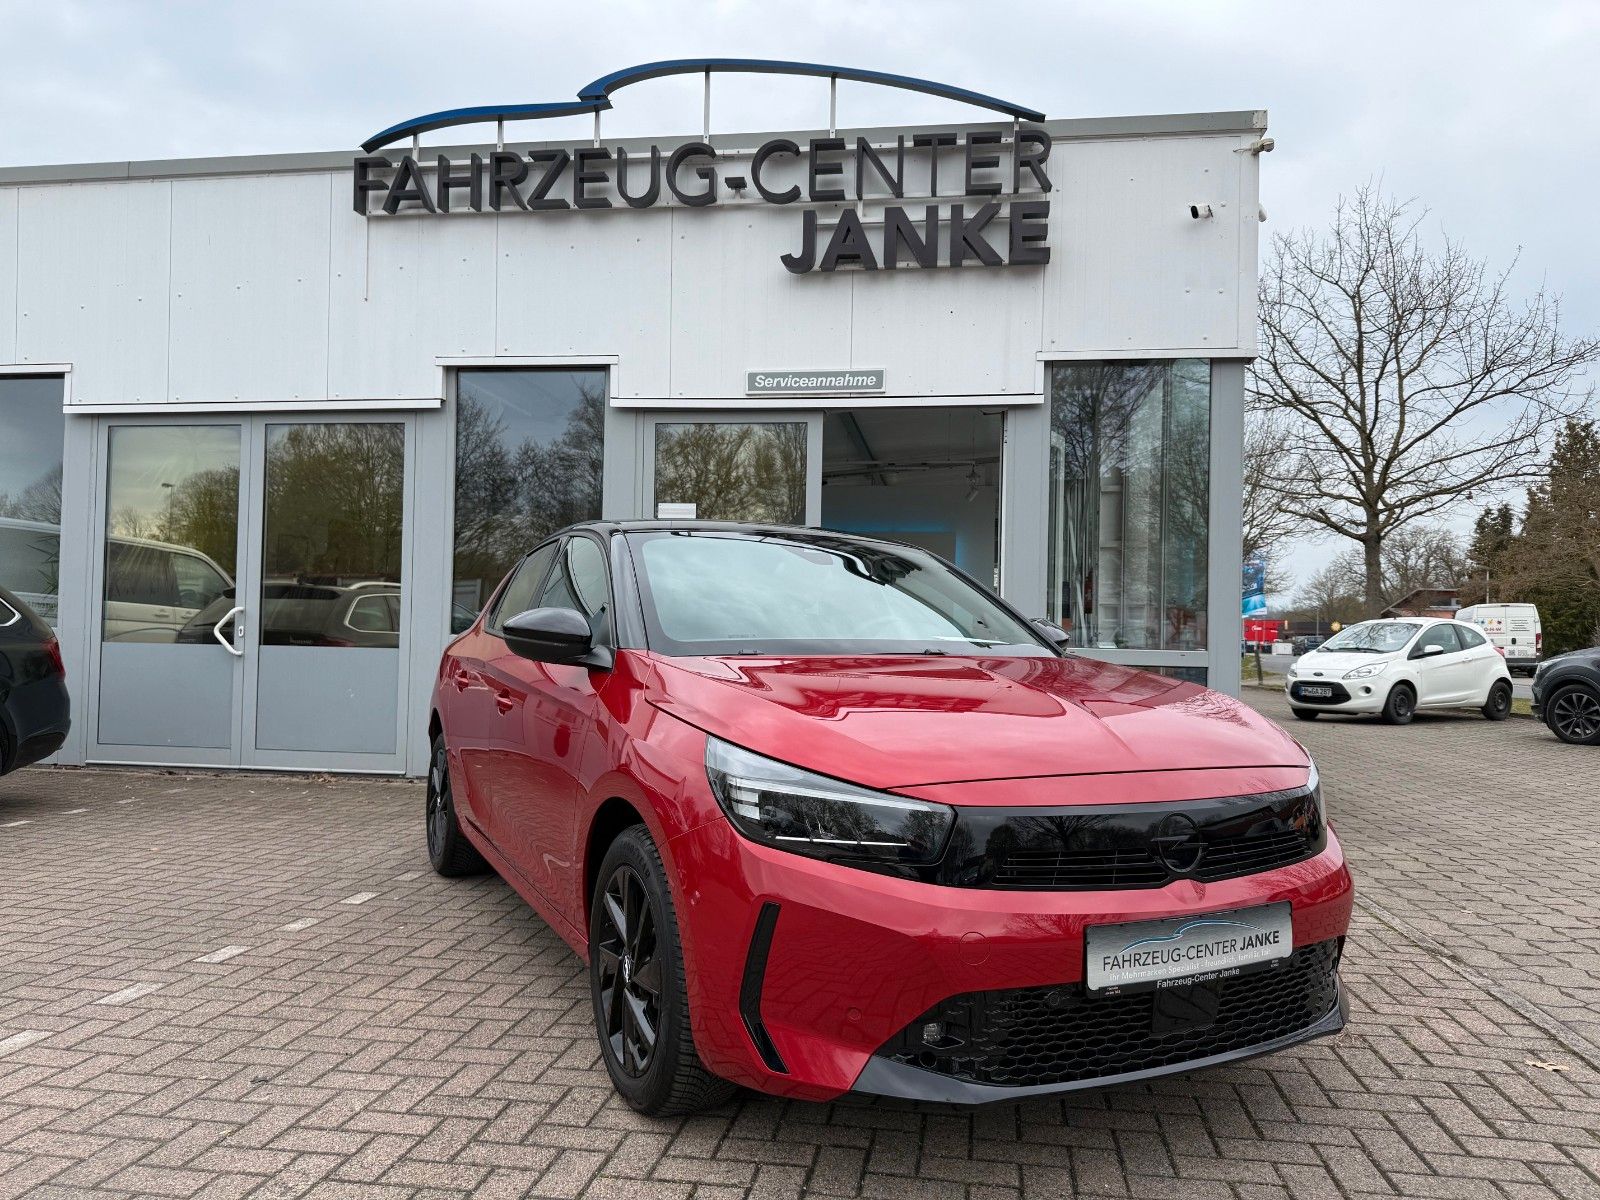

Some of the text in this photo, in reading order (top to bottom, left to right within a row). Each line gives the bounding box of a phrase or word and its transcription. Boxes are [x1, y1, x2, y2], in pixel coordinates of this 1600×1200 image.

[353, 129, 1052, 216] FAHRZEUG-CENTER
[780, 201, 1051, 274] JANKE
[754, 373, 877, 389] Serviceannahme
[1103, 931, 1280, 971] FAHRZEUG-CENTER JANKE
[1108, 972, 1120, 982] Ihr
[1156, 967, 1240, 989] Fahrzeug-Center Janke
